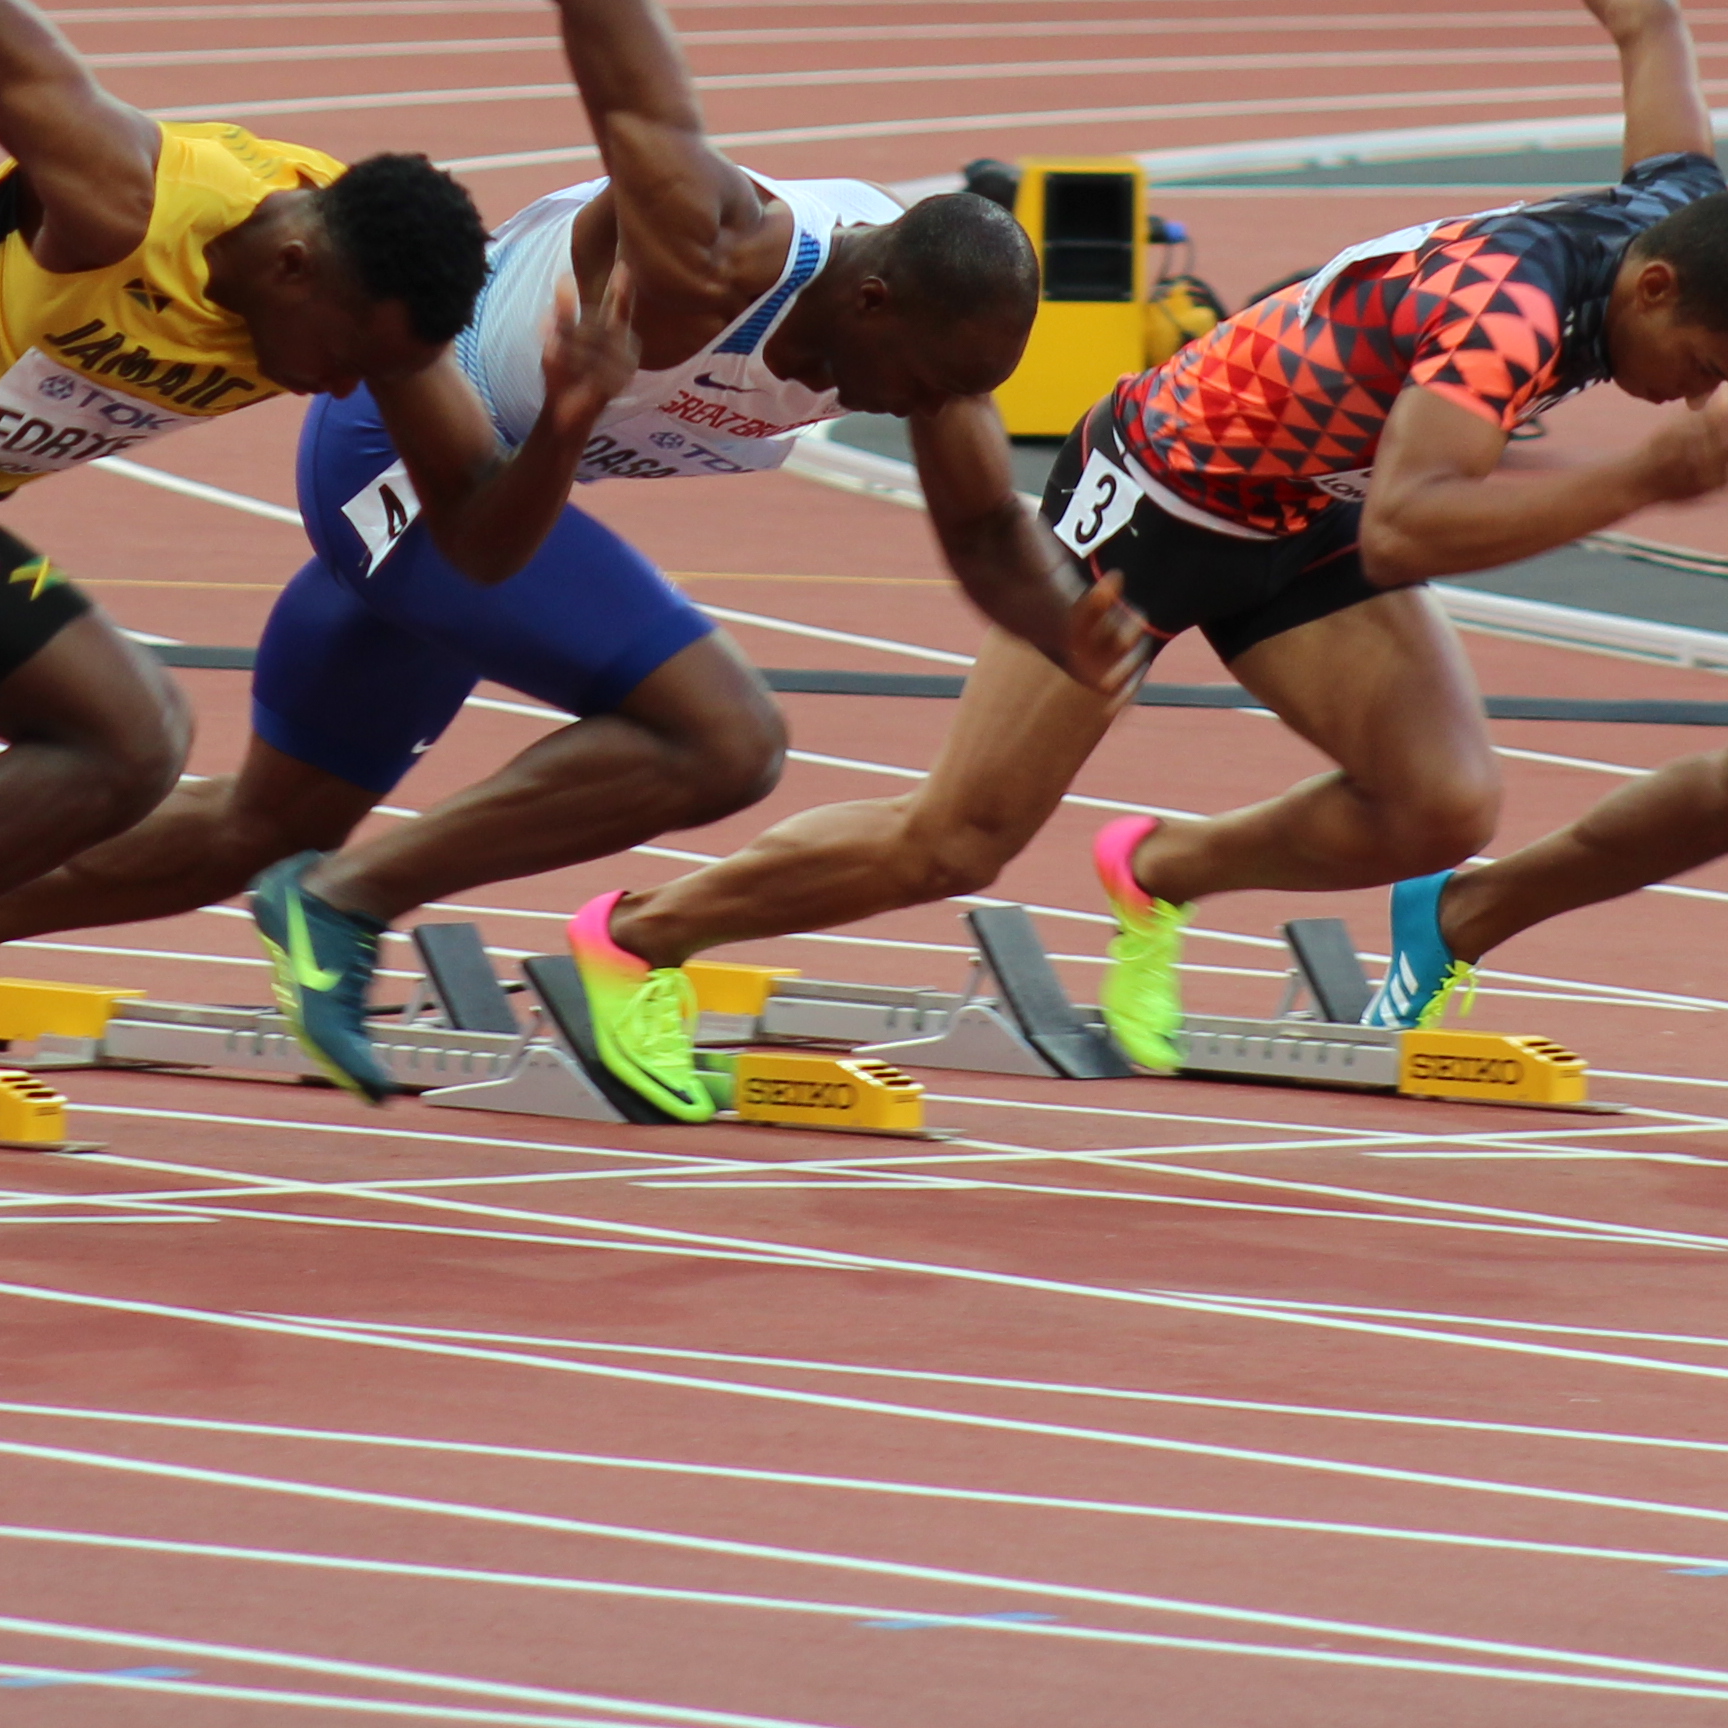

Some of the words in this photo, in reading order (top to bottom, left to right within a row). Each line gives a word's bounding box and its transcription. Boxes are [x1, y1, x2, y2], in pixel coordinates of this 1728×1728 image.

[42, 317, 268, 410] JAMAIC
[75, 387, 180, 431] TDK
[681, 442, 756, 473] TD
[1075, 473, 1117, 545] 3
[1409, 1052, 1525, 1085] SEIKO
[744, 1076, 859, 1110] SEIKO
